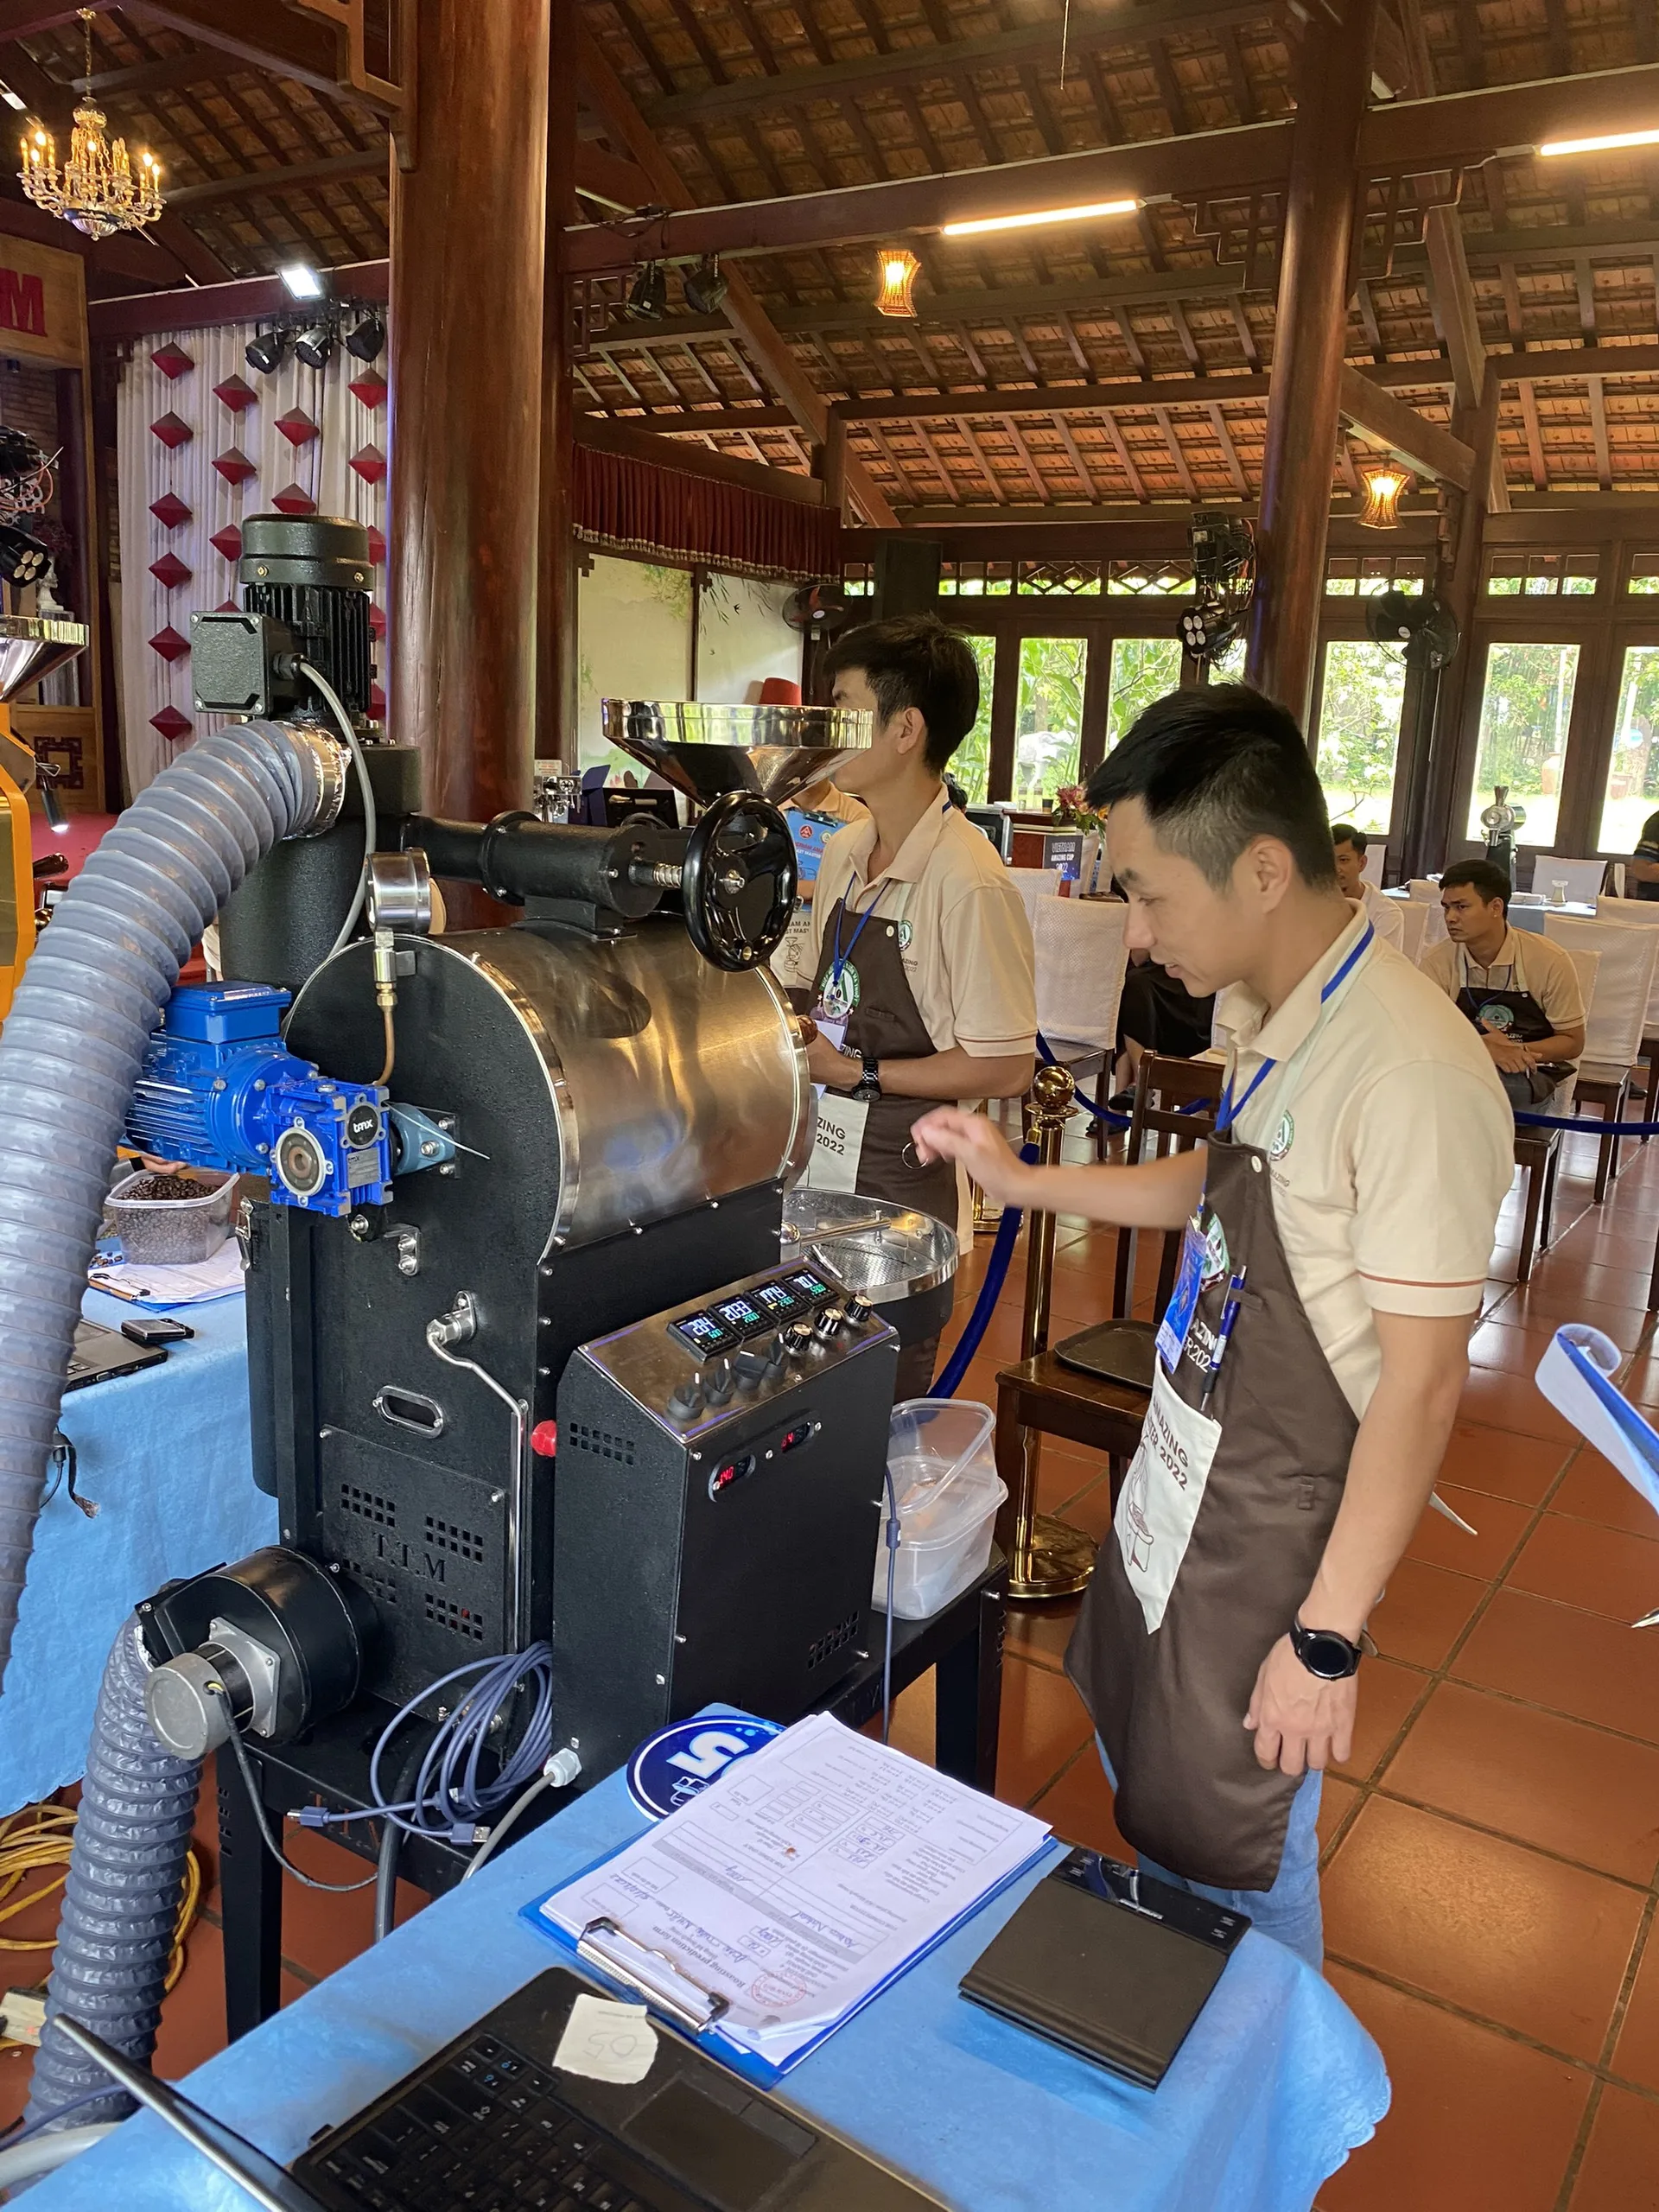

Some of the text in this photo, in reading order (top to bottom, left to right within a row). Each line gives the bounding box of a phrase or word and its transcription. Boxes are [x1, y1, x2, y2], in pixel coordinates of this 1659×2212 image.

[353, 1118, 373, 1134] tmx
[816, 1133, 845, 1156] 2022
[1160, 1446, 1188, 1491] 2022
[650, 1924, 672, 1940] form
[667, 1936, 713, 1965] prediction
[706, 1961, 748, 1988] Roasting
